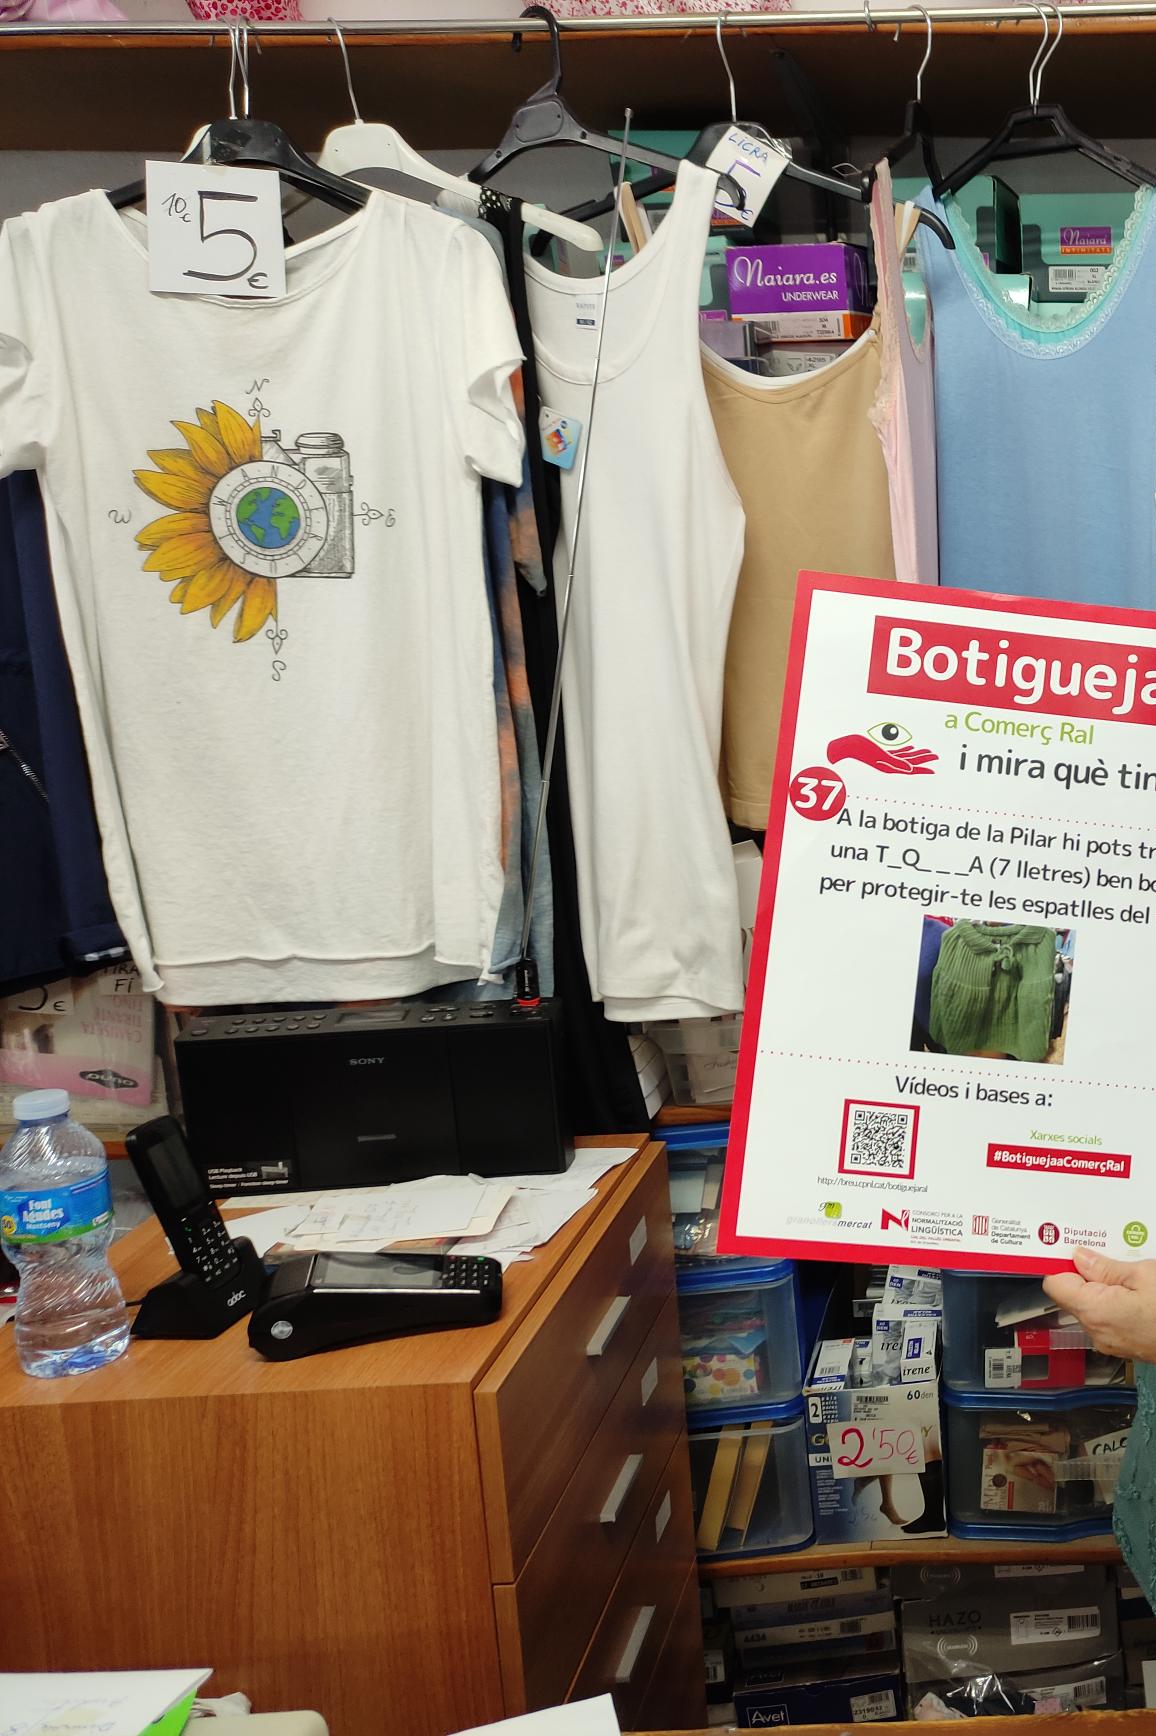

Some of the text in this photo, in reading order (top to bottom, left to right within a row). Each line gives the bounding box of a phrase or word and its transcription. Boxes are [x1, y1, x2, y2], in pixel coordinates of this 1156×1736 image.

[732, 255, 838, 289] Naiara.es
[781, 290, 839, 302] UNDERWEAR
[245, 378, 270, 395] N
[944, 711, 1095, 746] a Comerç Ral
[958, 743, 969, 772] i
[976, 749, 1046, 780] mira
[1053, 758, 1110, 791] què
[793, 776, 845, 812] 37
[836, 807, 853, 828] A
[858, 809, 877, 829] la
[882, 812, 951, 841] botiga
[955, 821, 981, 841] de
[986, 824, 1005, 844] la
[1009, 826, 1058, 851] Pilar
[1062, 832, 1081, 853] hi
[1086, 837, 1133, 859] pots
[830, 845, 869, 863] una
[989, 857, 1011, 878] (7
[1016, 860, 1092, 889] lletres)
[1096, 868, 1133, 891] ben
[819, 876, 856, 895] per
[861, 879, 982, 909] protegir-te
[988, 890, 1017, 911] les
[1022, 894, 1115, 922] espatlles
[1119, 905, 1150, 925] del
[349, 1057, 385, 1066] SONY
[895, 1075, 1054, 1107] Vídeos i bases a:
[1030, 1129, 1103, 1146] Xarxes socials
[993, 1149, 1125, 1173] #BotiguejaaComerçRal
[911, 1217, 964, 1227] NORMALITZACIÓ
[911, 1225, 964, 1237] LINGÜÍSTICA
[991, 1231, 1031, 1240] Departament
[1063, 1226, 1108, 1238] Diputació
[999, 1238, 1023, 1246] Cultura
[1063, 1236, 1107, 1248] Barcelona
[902, 1365, 931, 1376] irene
[906, 1390, 934, 1400] 60 den
[810, 1403, 820, 1418] 2
[928, 1610, 982, 1628] HAZO
[751, 1710, 786, 1725] Avet
